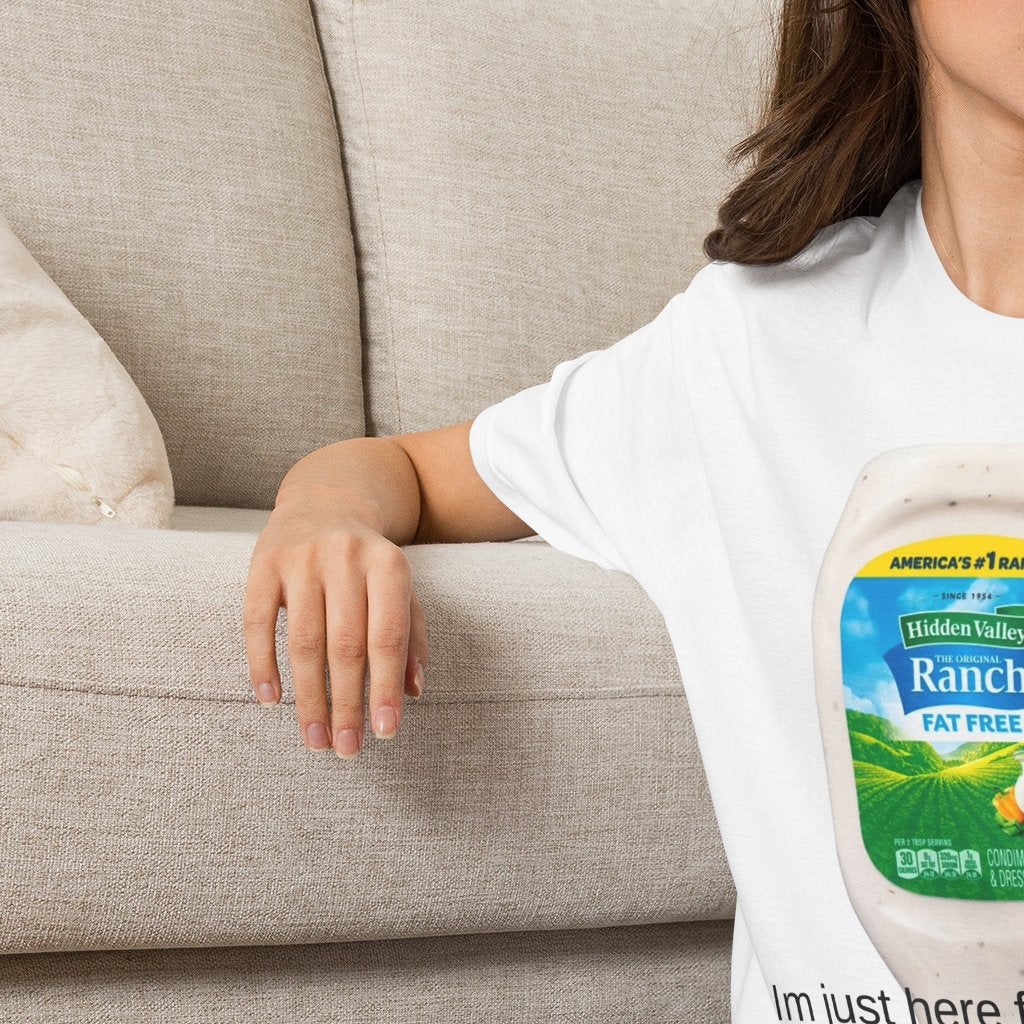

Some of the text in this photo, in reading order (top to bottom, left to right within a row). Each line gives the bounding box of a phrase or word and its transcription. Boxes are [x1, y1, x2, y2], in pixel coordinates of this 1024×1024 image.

[889, 556, 972, 570] AMERICA'S
[974, 551, 997, 570] #1
[941, 592, 993, 600] SINCE 1954
[906, 618, 972, 640] Hidden
[935, 654, 1002, 665] THE ORIGINAL
[922, 713, 1023, 734] FAT FREE
[894, 838, 906, 847] PER
[911, 838, 926, 847] TBSP
[927, 838, 952, 847] SERVING
[899, 851, 913, 866] 30
[990, 869, 998, 888] &
[772, 984, 816, 1022] Im
